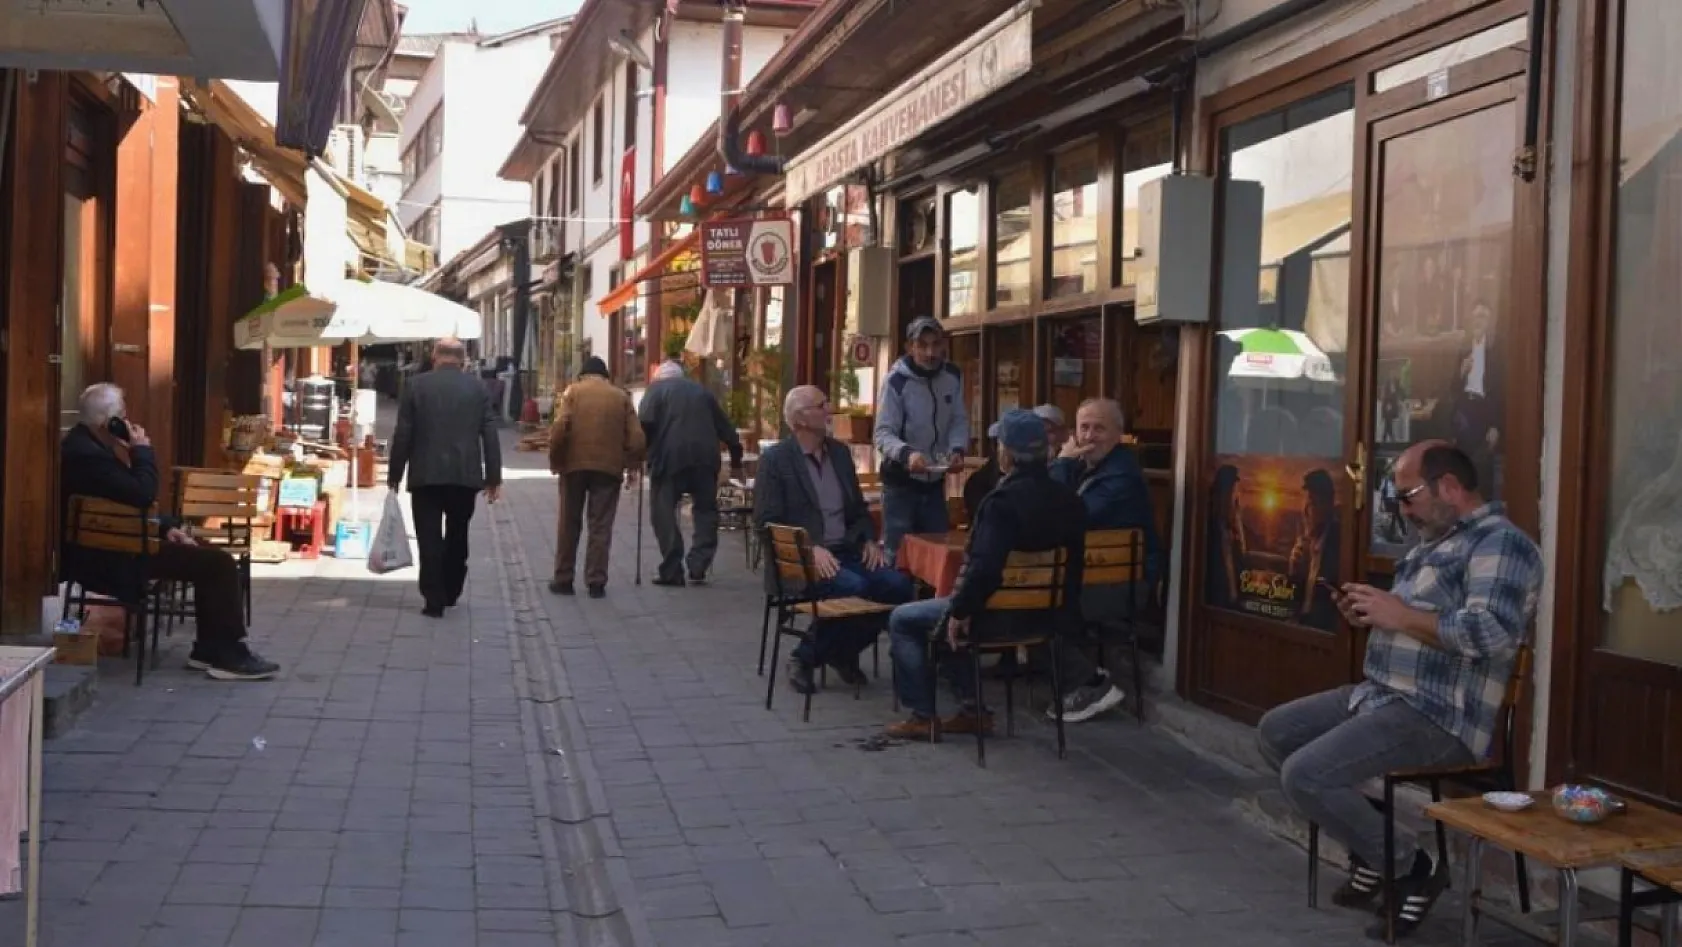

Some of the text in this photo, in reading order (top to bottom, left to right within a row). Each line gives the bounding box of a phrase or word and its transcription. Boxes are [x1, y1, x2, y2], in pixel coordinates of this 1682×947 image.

[815, 59, 968, 185] ARASTA KAHVEHANESİ
[710, 228, 739, 238] TATLI
[707, 240, 743, 250] DÖNER
